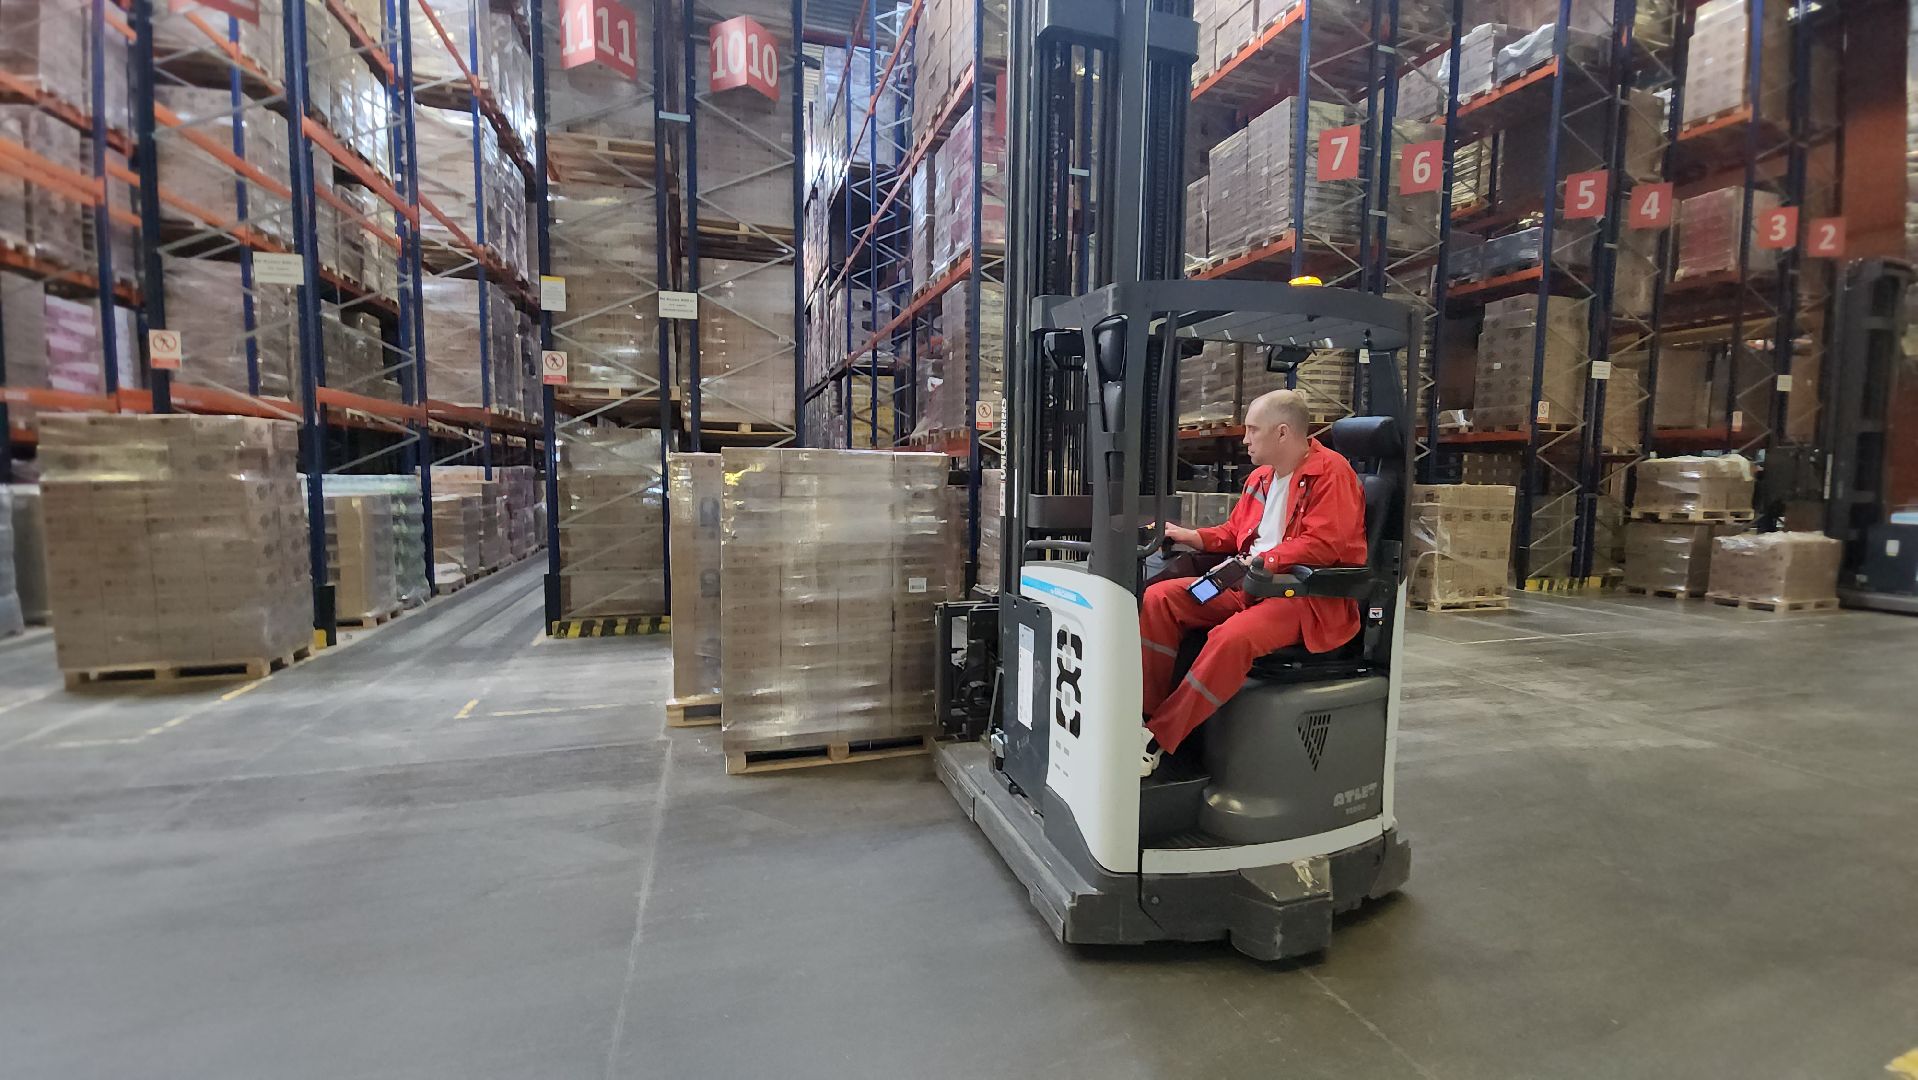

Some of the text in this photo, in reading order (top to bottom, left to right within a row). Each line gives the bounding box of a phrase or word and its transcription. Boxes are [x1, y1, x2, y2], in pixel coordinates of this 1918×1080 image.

[561, 3, 593, 57] 11
[596, 6, 635, 68] 11
[712, 30, 744, 80] 10
[747, 33, 778, 88] 10
[1330, 136, 1349, 171] 7
[1412, 151, 1431, 184] 6
[1577, 179, 1596, 210] 5
[1640, 191, 1660, 219] 4
[1769, 214, 1787, 241] 3
[1818, 224, 1836, 250] 2
